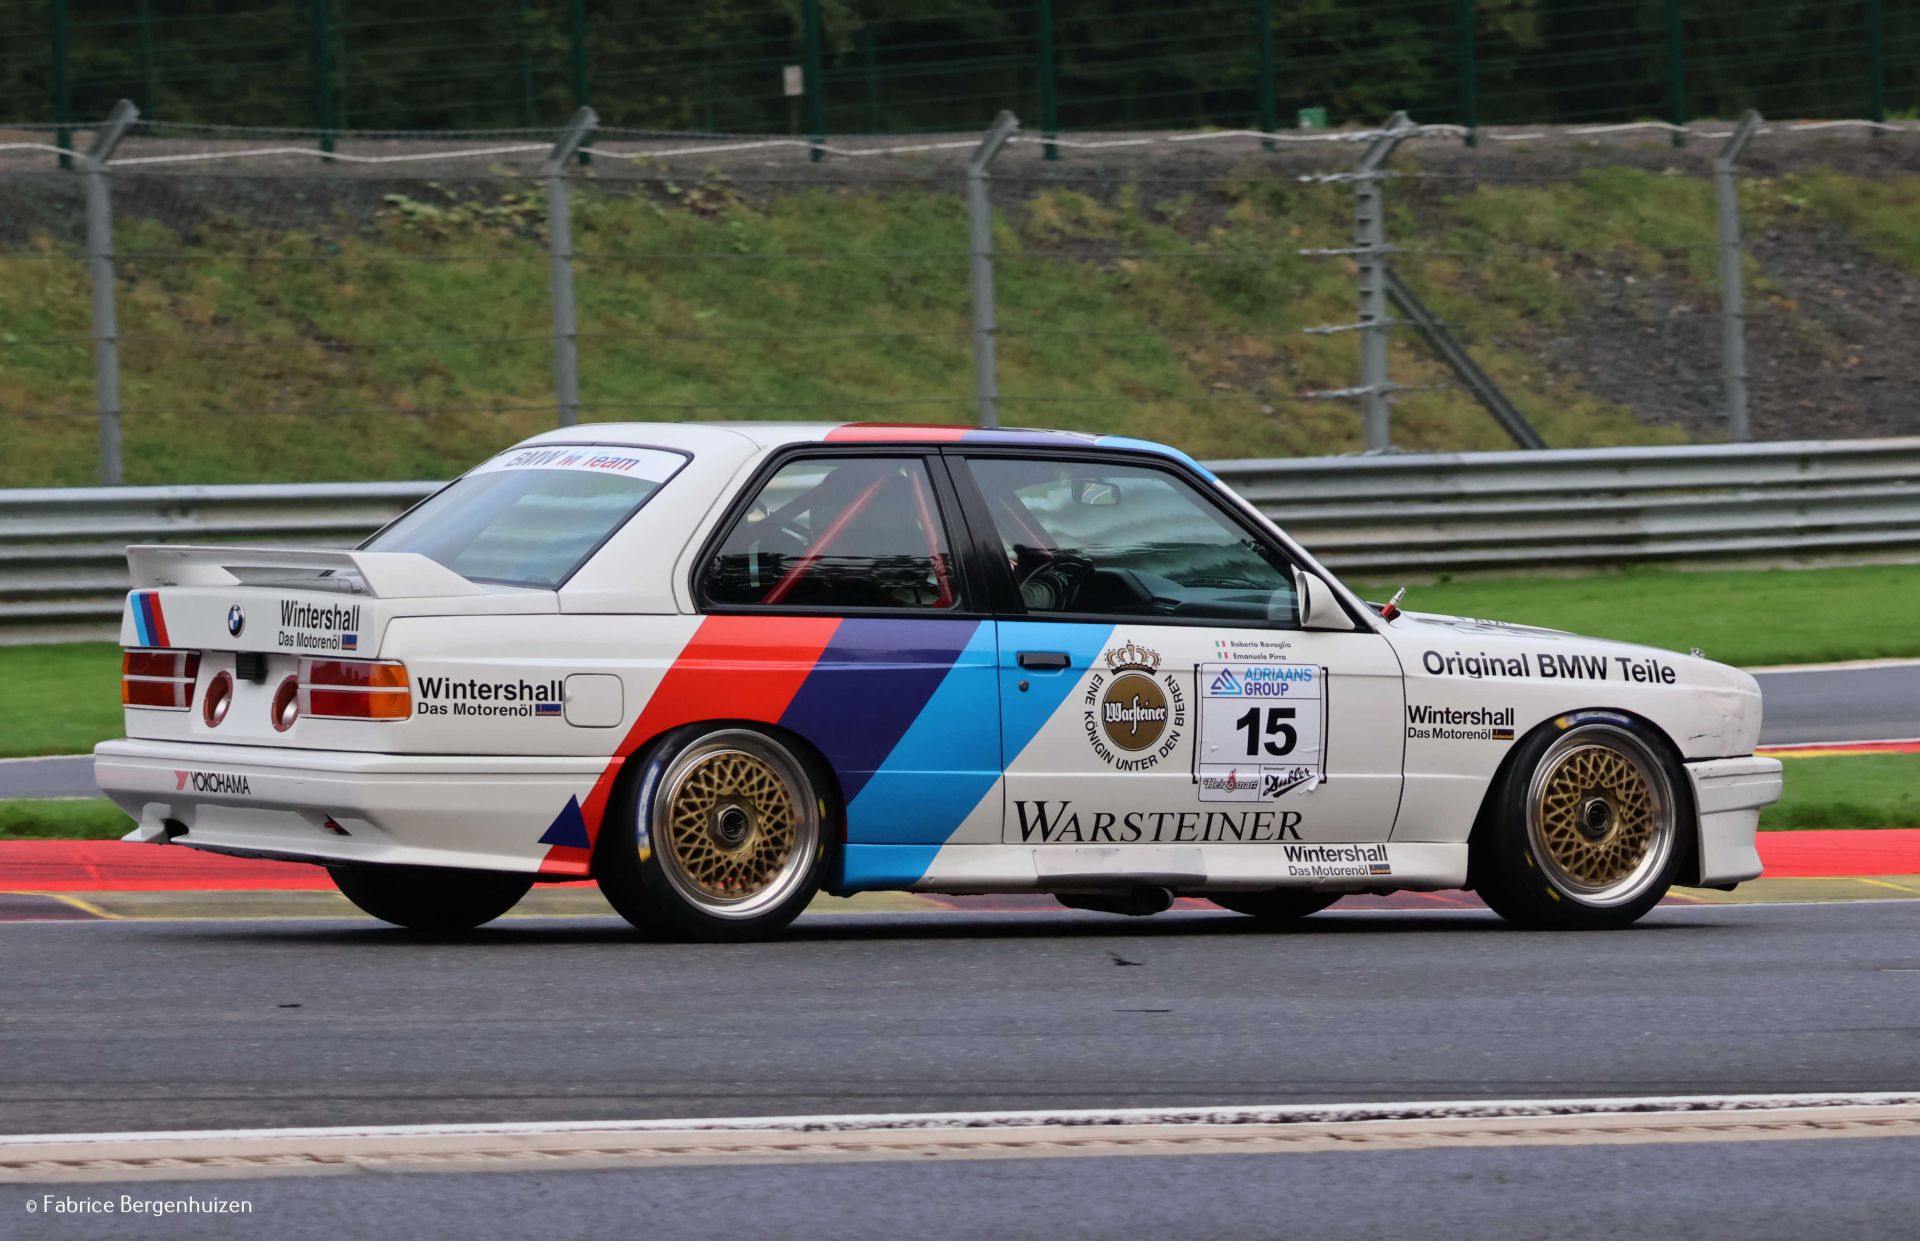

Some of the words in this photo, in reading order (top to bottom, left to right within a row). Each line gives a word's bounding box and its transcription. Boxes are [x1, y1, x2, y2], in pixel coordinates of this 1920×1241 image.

[504, 450, 568, 467] BMW
[582, 451, 641, 472] Team
[281, 600, 360, 631] Wintershall
[278, 631, 294, 646] Das
[297, 633, 340, 650] Motorenöl
[1260, 642, 1292, 650] Ravaglia
[1244, 668, 1312, 682] ADRIAANS
[1422, 650, 1530, 679] Original
[1536, 653, 1607, 680] BMW
[1615, 657, 1676, 684] Teile
[417, 677, 563, 702] Wintershall
[1085, 673, 1104, 706] EINE
[1245, 682, 1289, 696] GROUP
[417, 702, 448, 715] Das
[453, 703, 532, 717] Motorenöl
[1164, 674, 1185, 727] BIEREN
[1407, 705, 1514, 726] Wintershall
[1084, 710, 1115, 764] KÖNIGIN
[1236, 707, 1298, 757] 15
[1407, 727, 1430, 738] Das
[1432, 728, 1491, 740] Motorenöl
[1158, 730, 1181, 758] DEN
[1115, 754, 1158, 771] UNTER
[190, 771, 251, 795] YOKOHAMA
[1013, 800, 1304, 843] WARSTEINER
[1283, 844, 1388, 863] Wintershall
[1288, 866, 1311, 876] Das
[1312, 865, 1369, 876] Motorenöl
